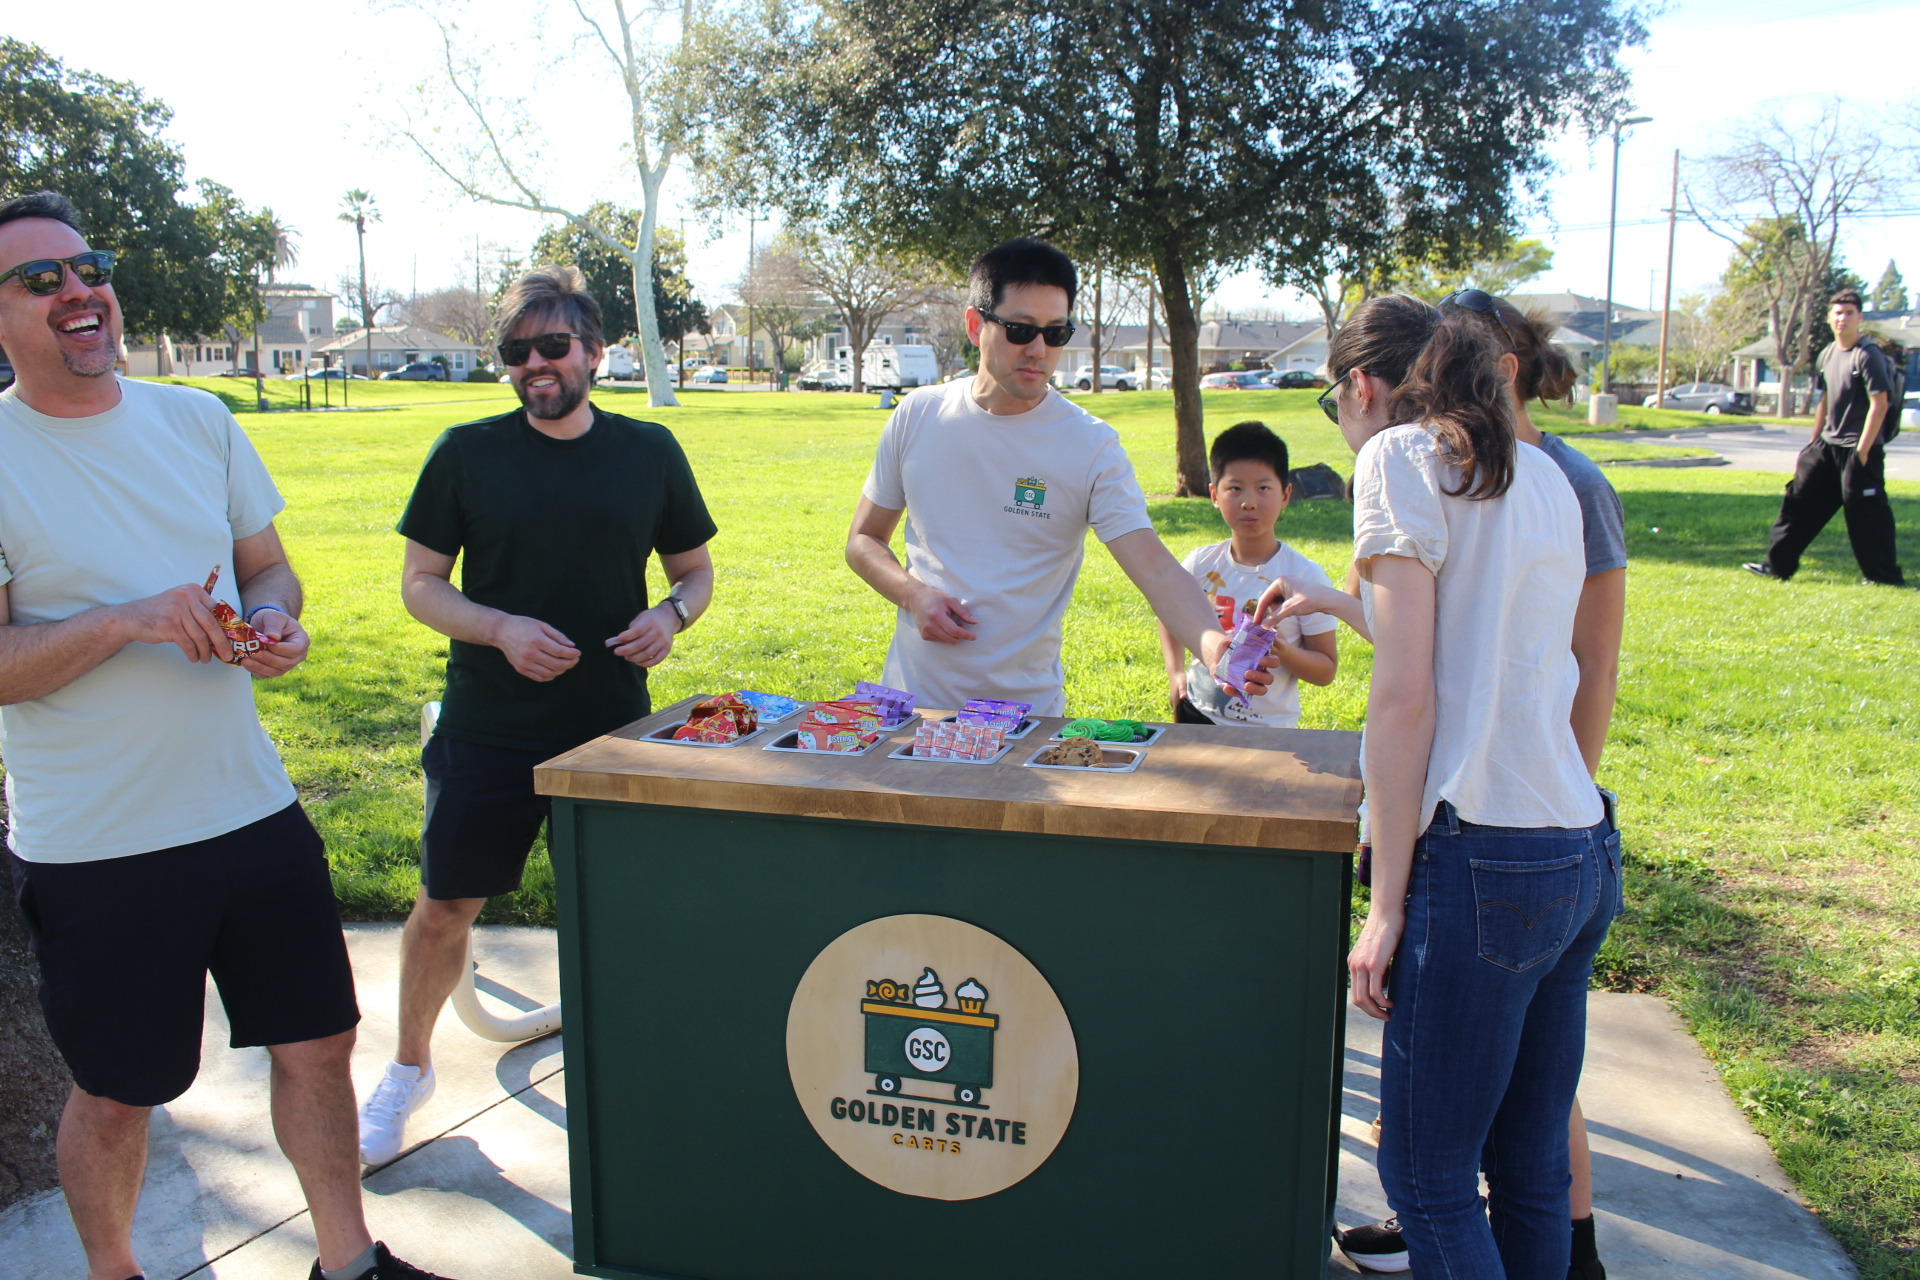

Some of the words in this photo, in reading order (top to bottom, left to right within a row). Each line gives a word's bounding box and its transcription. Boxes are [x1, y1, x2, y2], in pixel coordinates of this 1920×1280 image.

[1003, 506, 1029, 516] GOLDEN
[1031, 511, 1051, 519] STATE
[909, 1037, 946, 1062] GSC
[830, 1096, 935, 1132] GOLDEN
[945, 1112, 1027, 1146] STATE
[891, 1133, 961, 1155] CARTS
